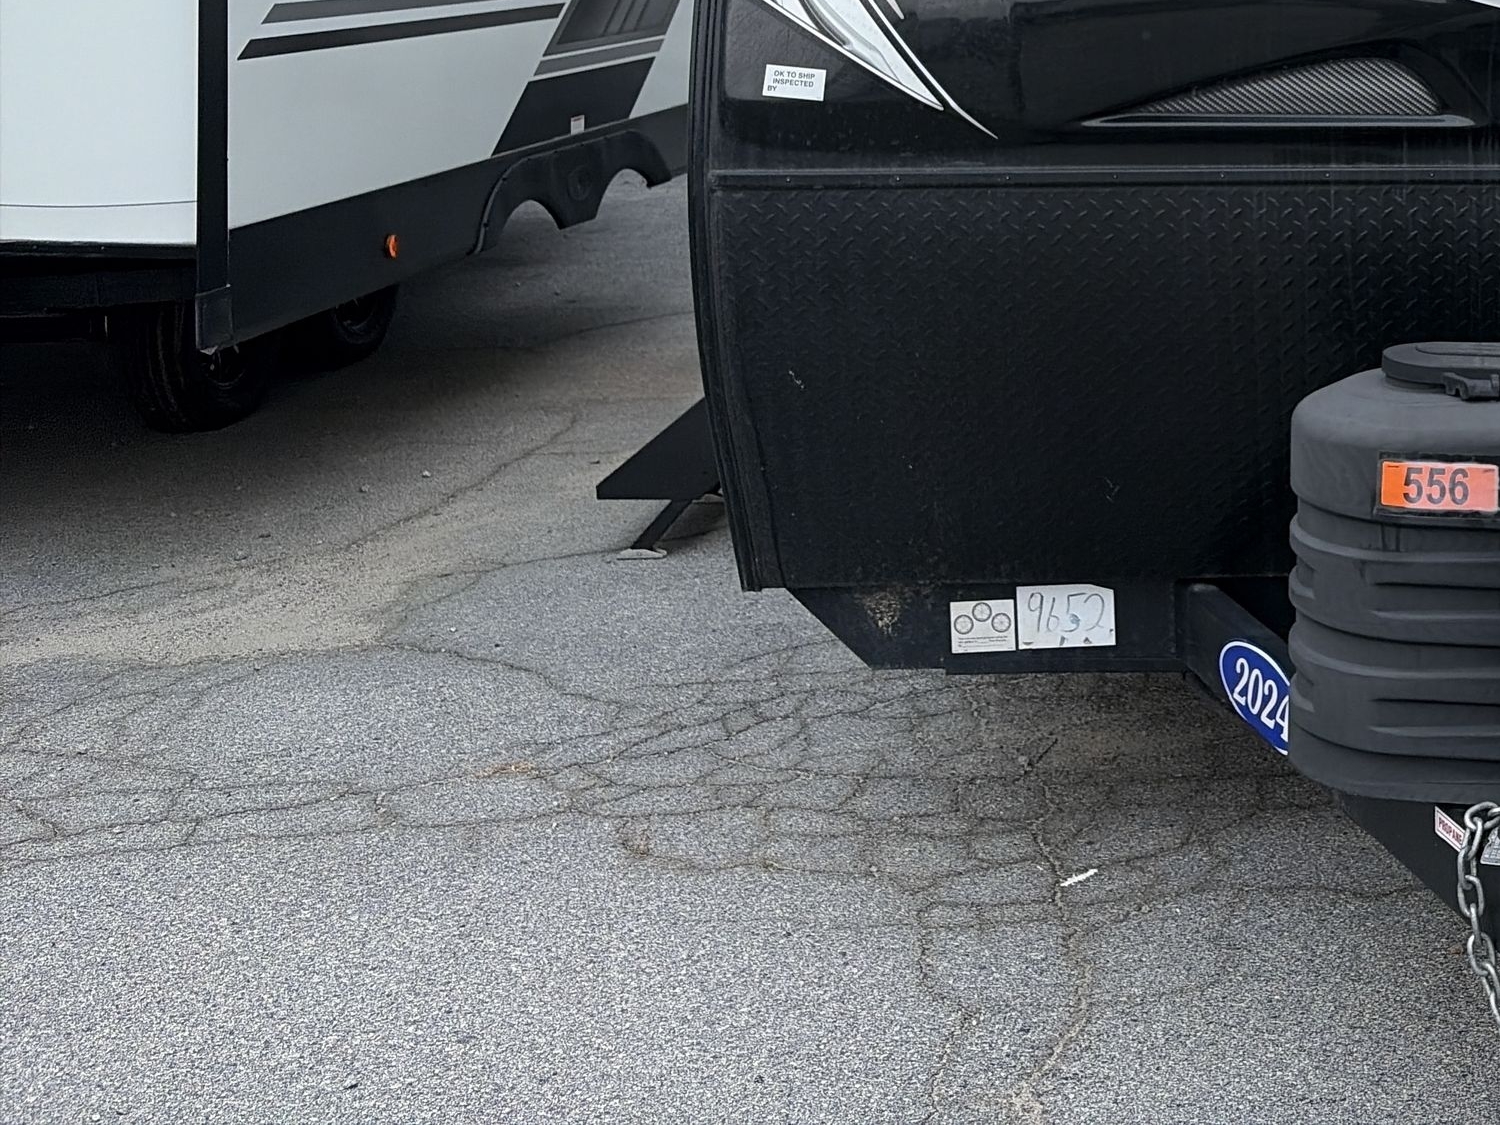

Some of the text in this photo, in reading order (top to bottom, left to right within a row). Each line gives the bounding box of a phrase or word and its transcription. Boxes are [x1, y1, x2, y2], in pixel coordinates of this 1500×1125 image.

[772, 78, 814, 87] INSPECTED
[1403, 466, 1470, 506] 556
[1027, 591, 1106, 633] 9652
[1233, 657, 1290, 743] 2024
